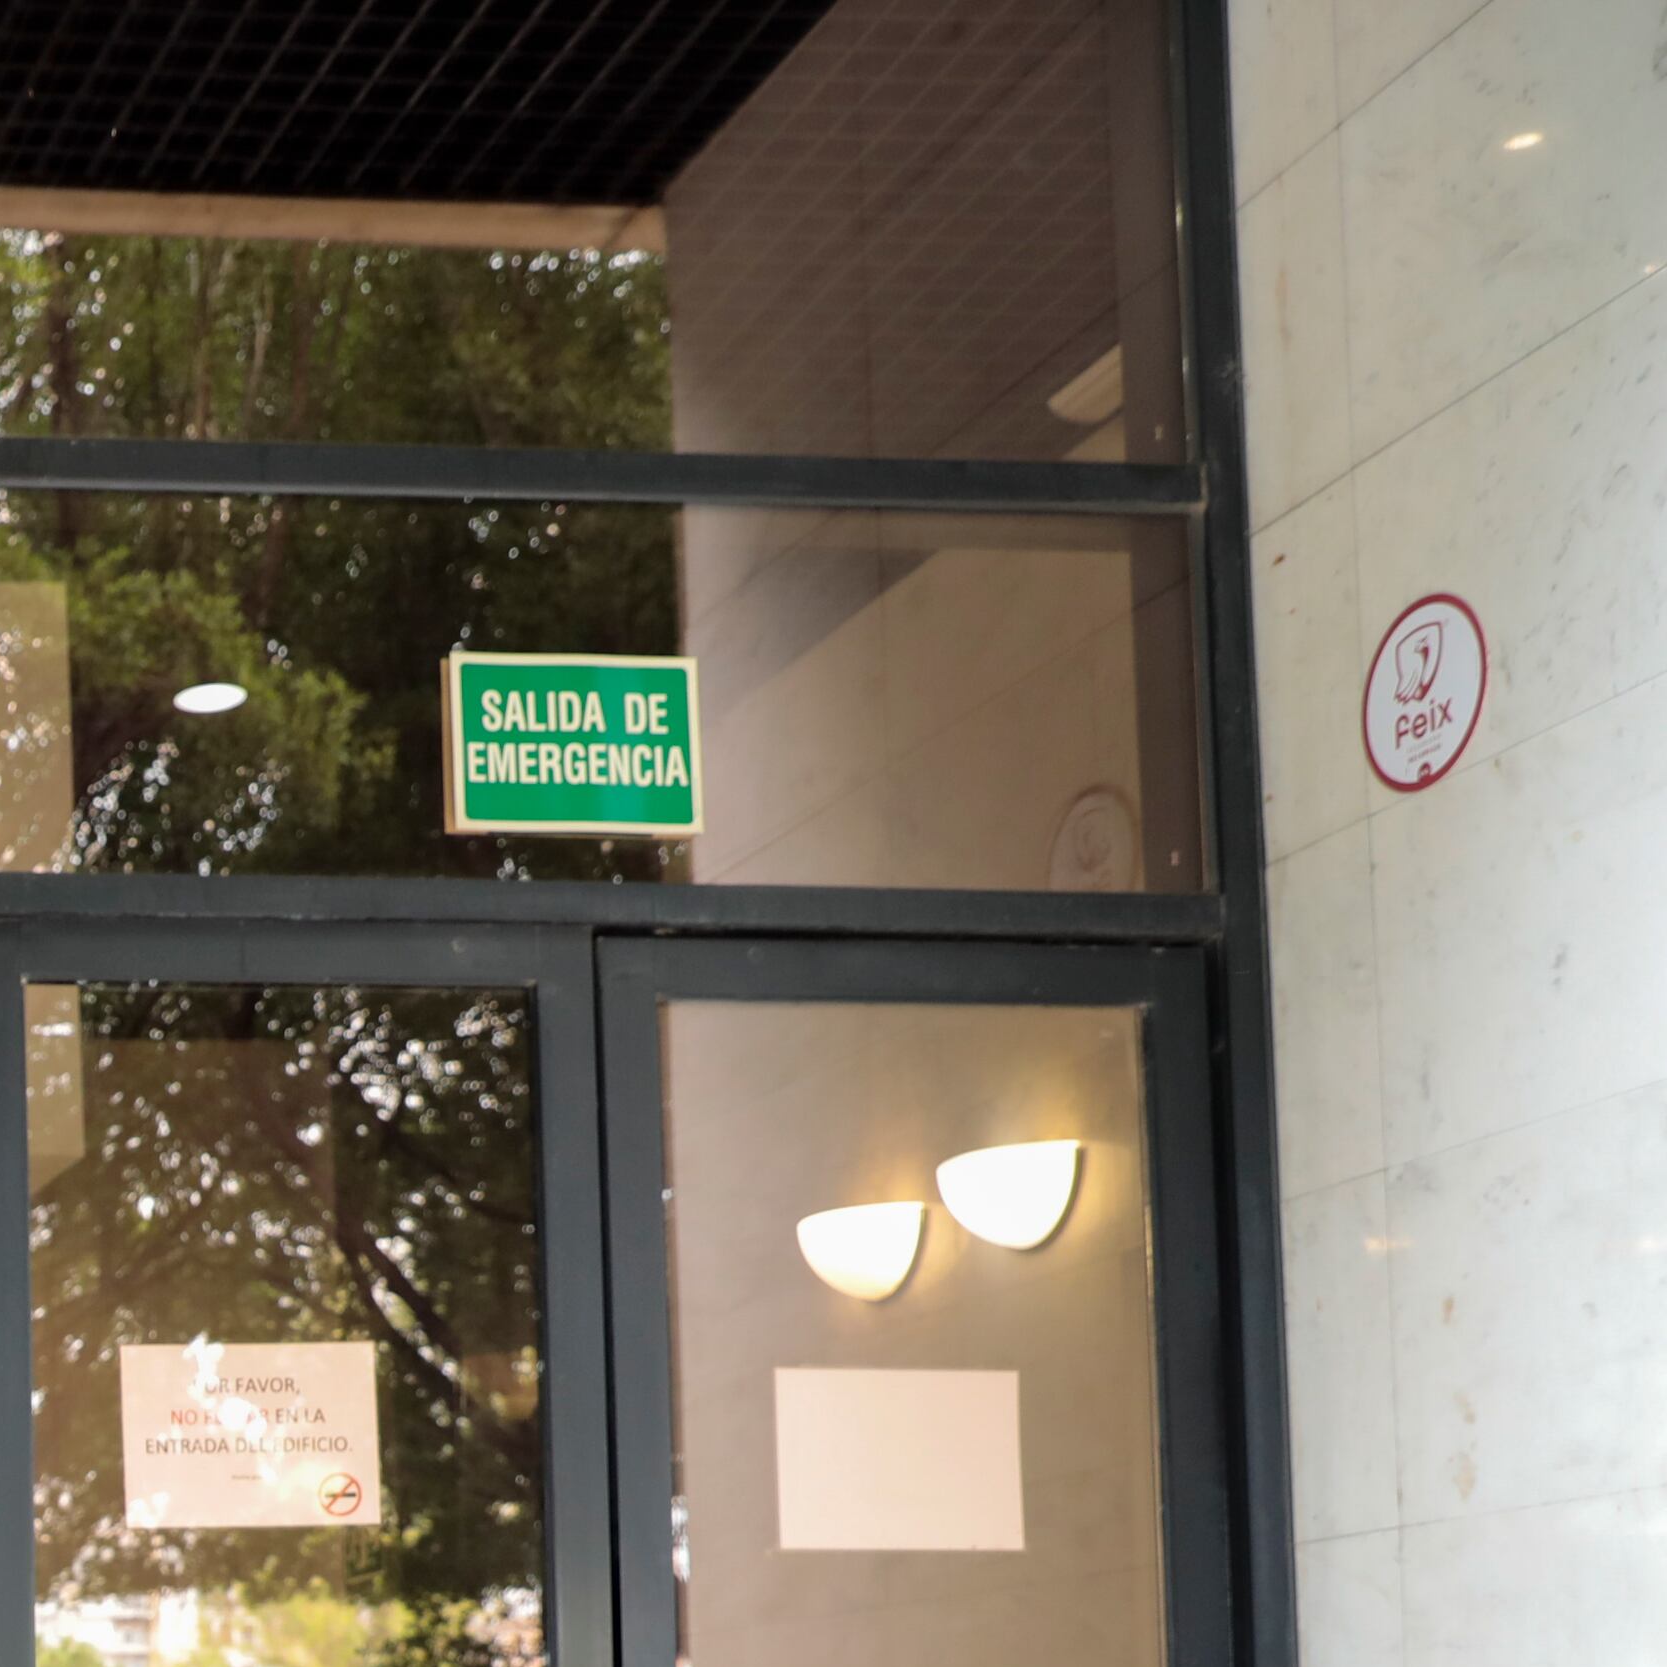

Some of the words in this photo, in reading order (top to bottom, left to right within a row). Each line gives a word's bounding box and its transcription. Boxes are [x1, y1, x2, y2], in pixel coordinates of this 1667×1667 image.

[481, 689, 607, 733] SALIDA
[623, 693, 669, 735] DE
[1395, 698, 1453, 750] feix
[467, 741, 689, 787] EMERGENCIA
[194, 1378, 230, 1395] OR
[235, 1377, 300, 1396] FAVOR,
[170, 1409, 198, 1426] NO
[204, 1408, 268, 1425] FAR
[275, 1408, 299, 1424] EN
[304, 1408, 326, 1424] LA
[145, 1437, 230, 1455] ENTRADA
